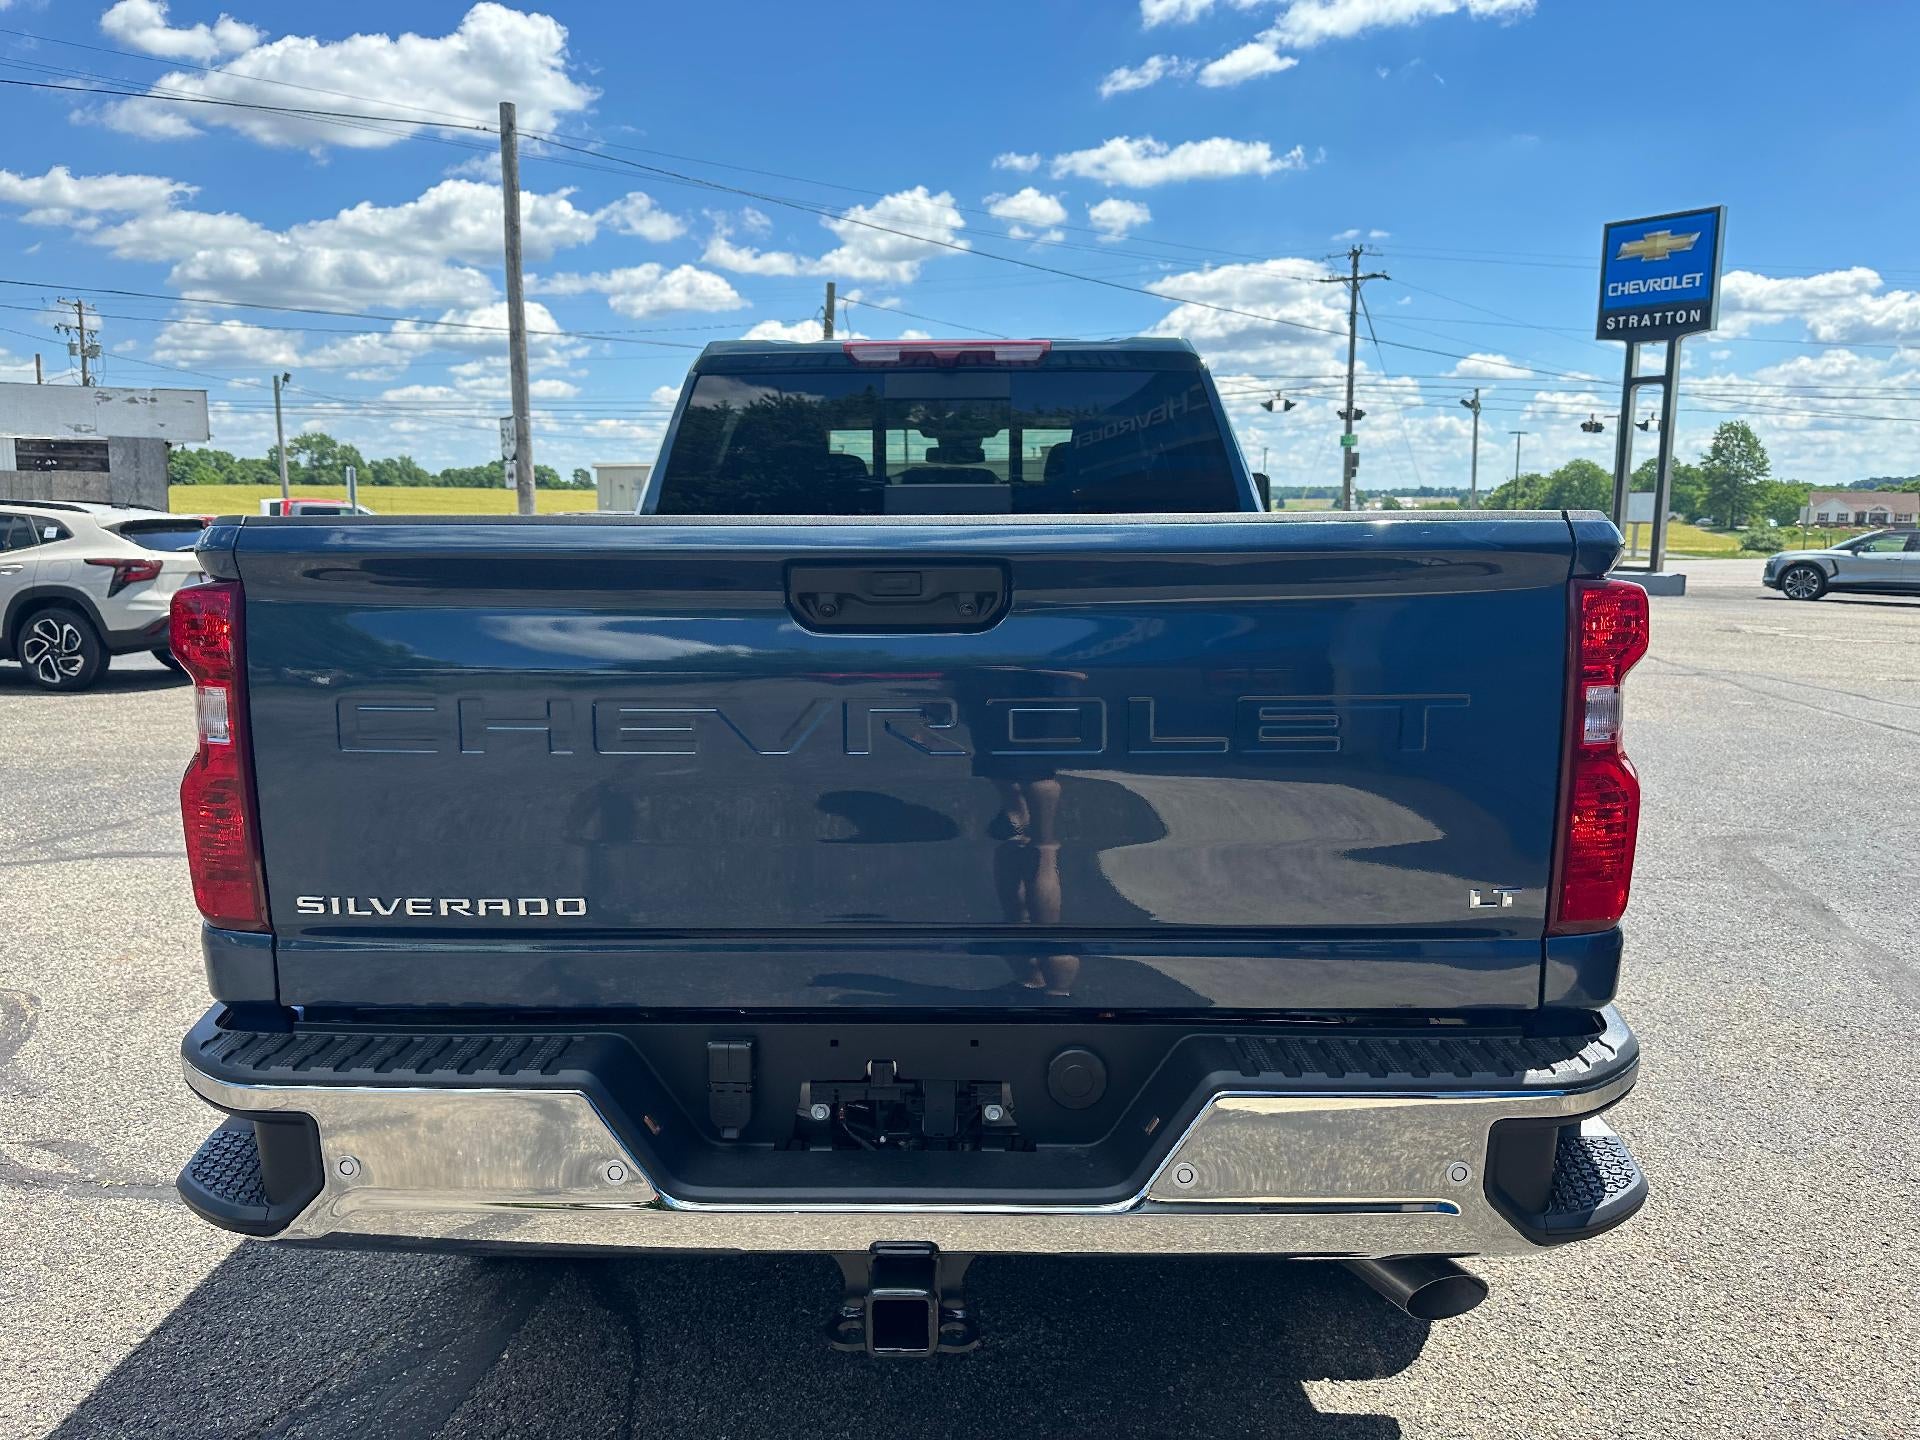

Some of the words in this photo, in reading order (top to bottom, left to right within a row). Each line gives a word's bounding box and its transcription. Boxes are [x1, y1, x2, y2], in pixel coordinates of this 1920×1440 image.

[1608, 272, 1704, 297] CHEVROLET
[1606, 309, 1701, 330] STRATTON
[336, 694, 1470, 755] CHEVROLET
[296, 896, 587, 916] SILVERADO
[1469, 888, 1522, 909] LT
